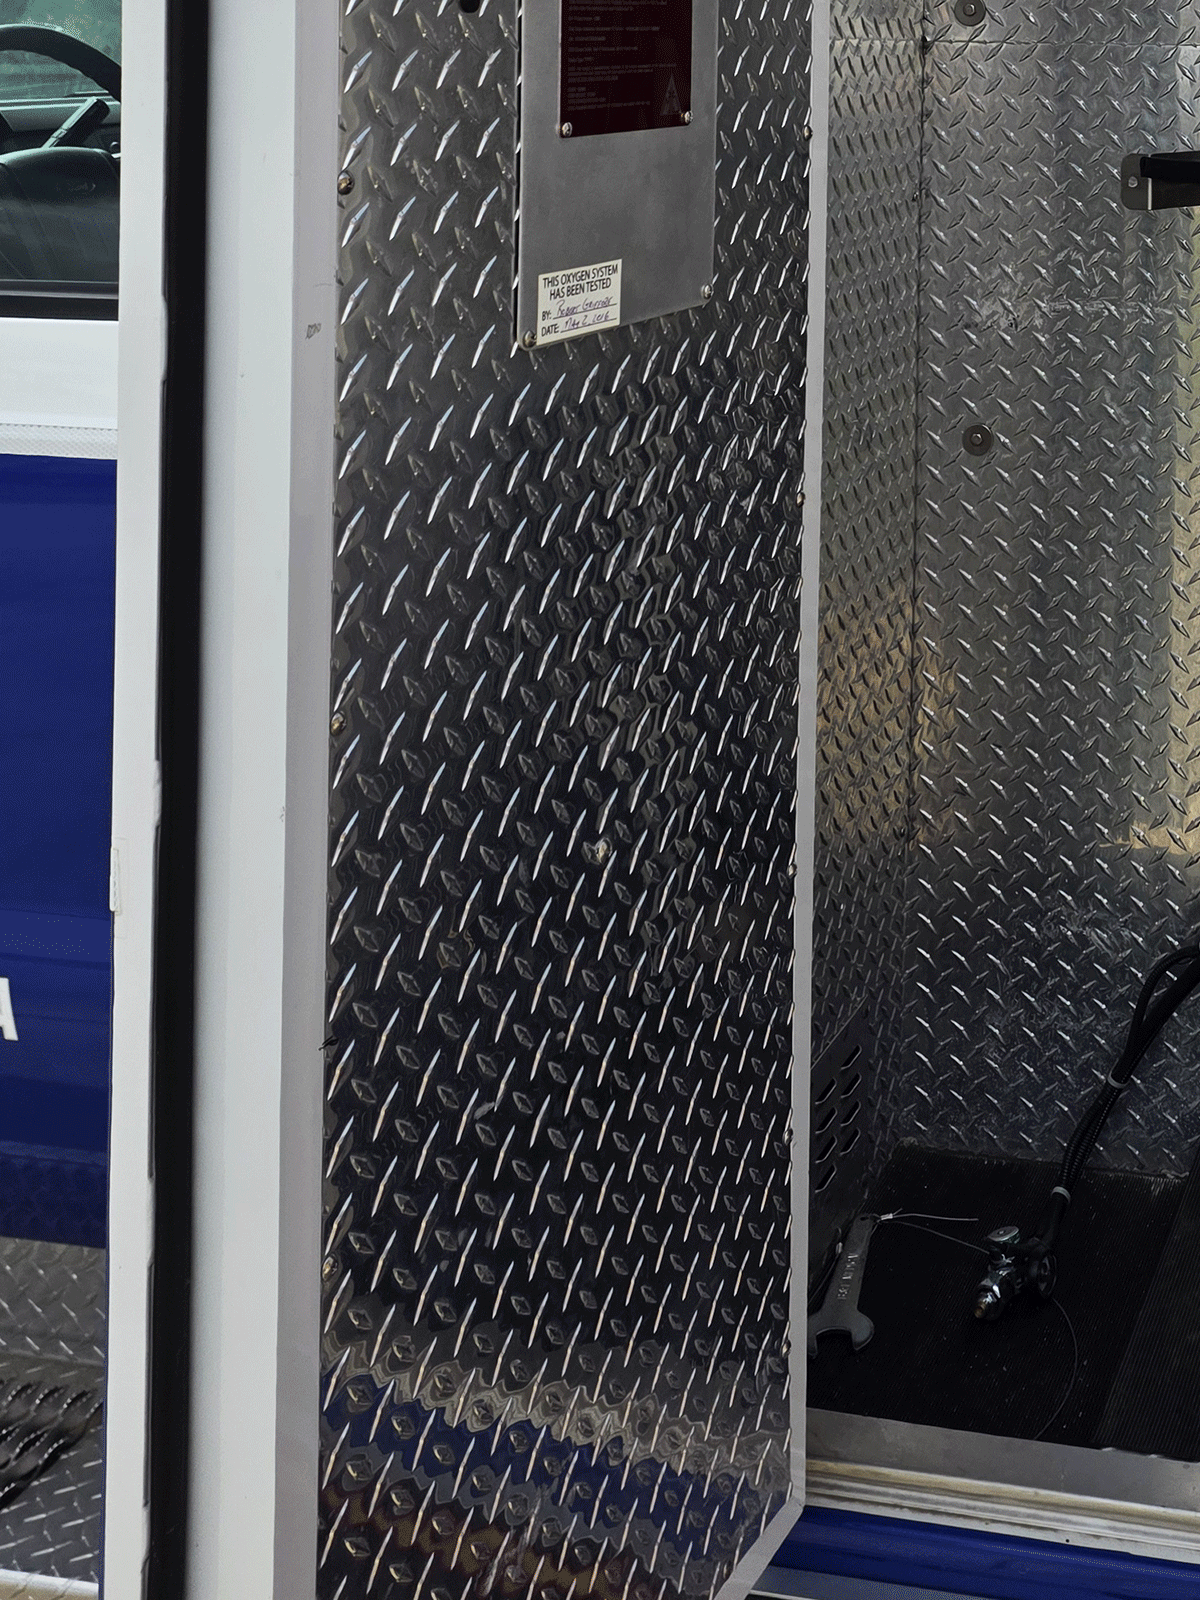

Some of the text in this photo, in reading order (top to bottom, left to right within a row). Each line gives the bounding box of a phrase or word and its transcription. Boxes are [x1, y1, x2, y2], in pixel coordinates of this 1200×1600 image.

[543, 264, 618, 288] THIS OXYGEN SYSTEM
[550, 278, 612, 301] HAS BEEN TESTED
[541, 309, 552, 321] BY:
